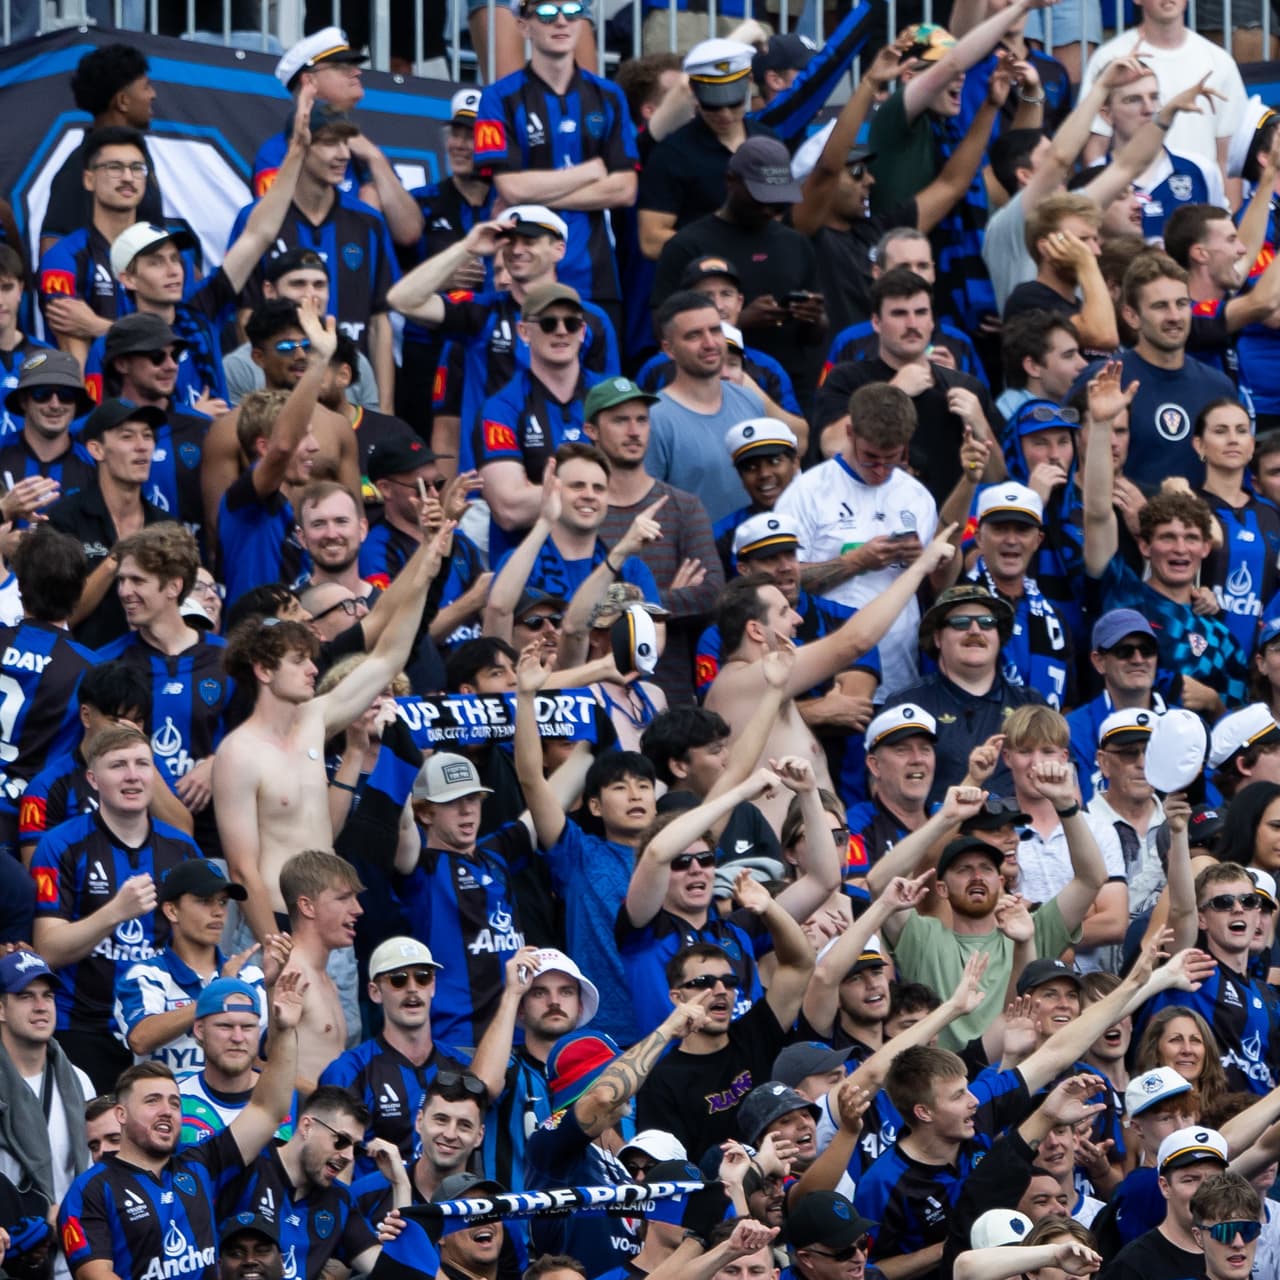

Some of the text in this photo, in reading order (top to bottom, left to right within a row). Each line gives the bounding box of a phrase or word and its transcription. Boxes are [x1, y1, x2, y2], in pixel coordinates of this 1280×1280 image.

[3, 646, 53, 674] DAY
[396, 695, 597, 732] UP THE ORT
[467, 930, 526, 955] Anch
